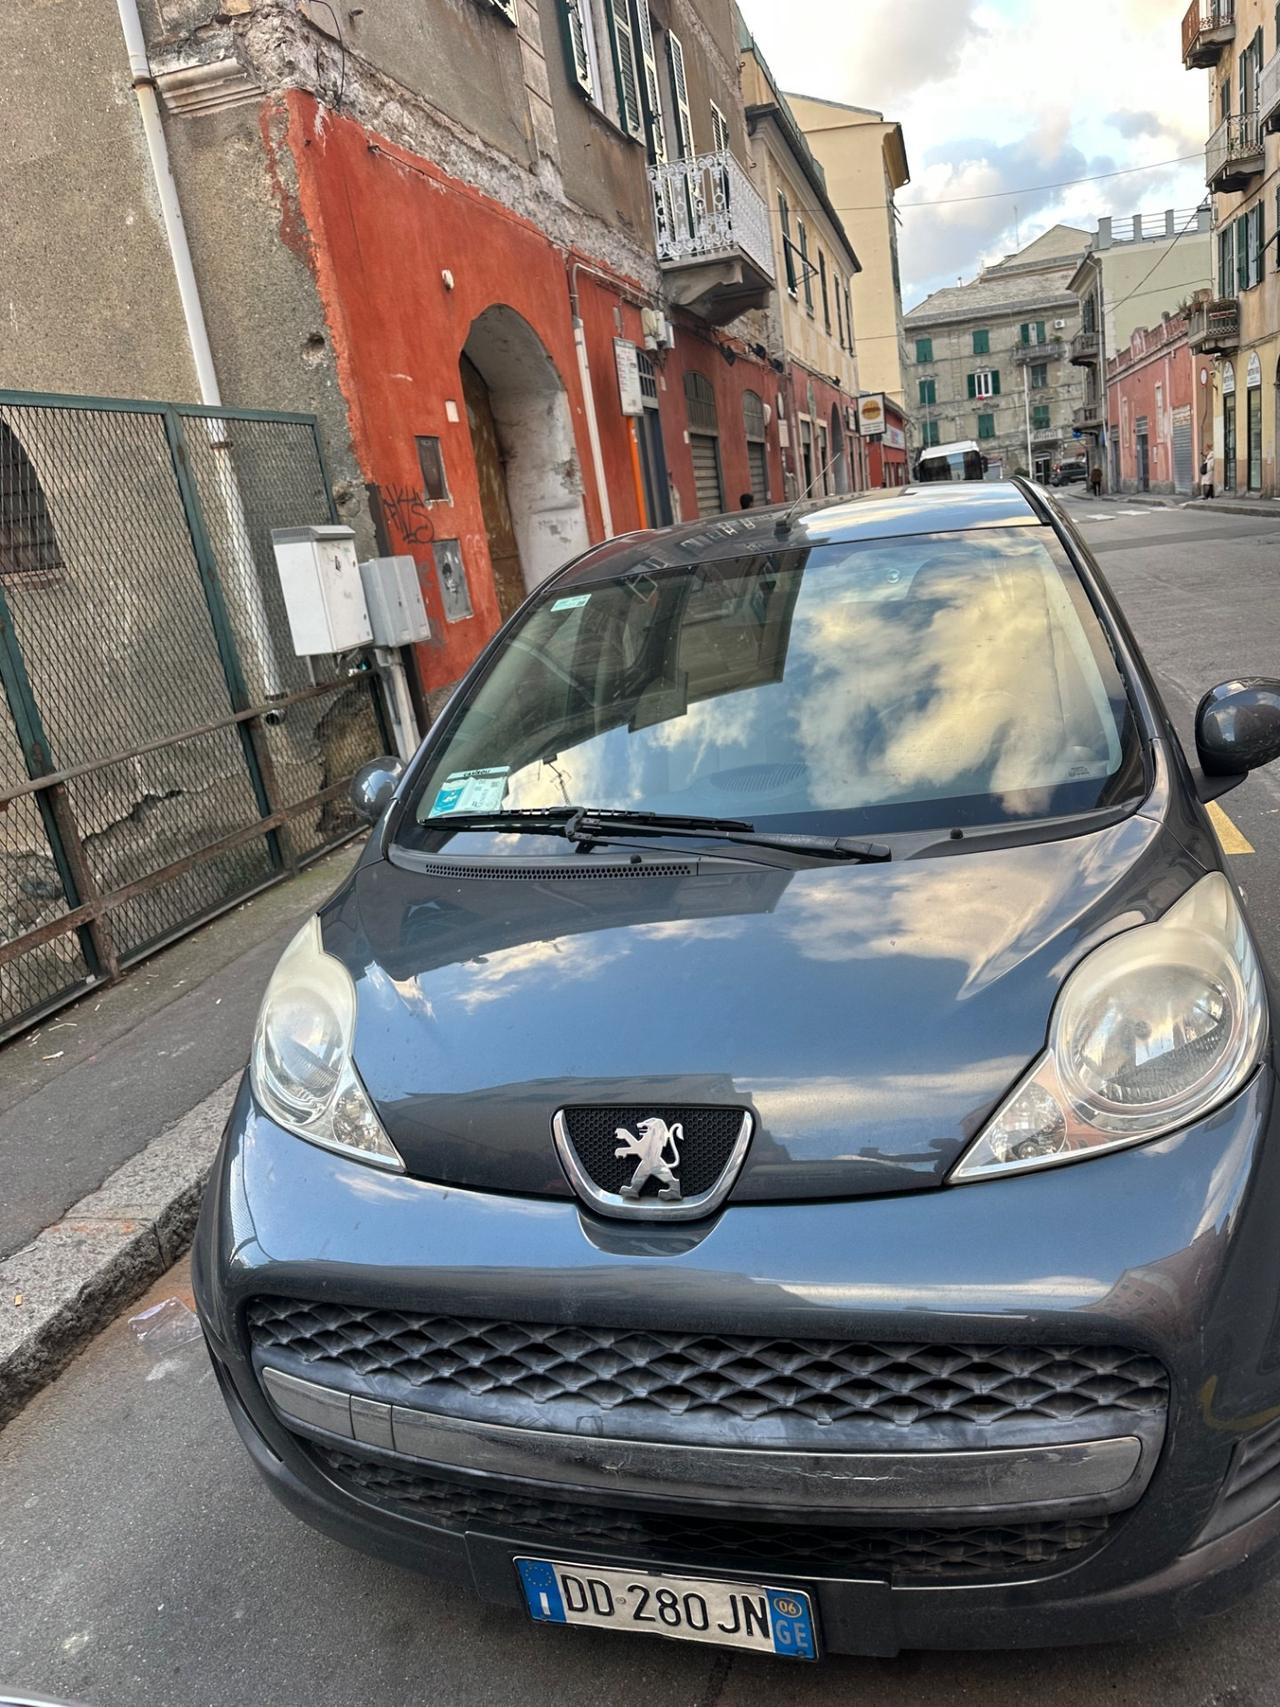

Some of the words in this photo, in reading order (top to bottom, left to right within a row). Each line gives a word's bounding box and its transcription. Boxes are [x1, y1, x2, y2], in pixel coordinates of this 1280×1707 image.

[561, 1574, 614, 1616] DD
[627, 1584, 709, 1630] 280
[718, 1594, 771, 1639] JN
[778, 1601, 797, 1614] 06
[776, 1619, 809, 1648] GE
